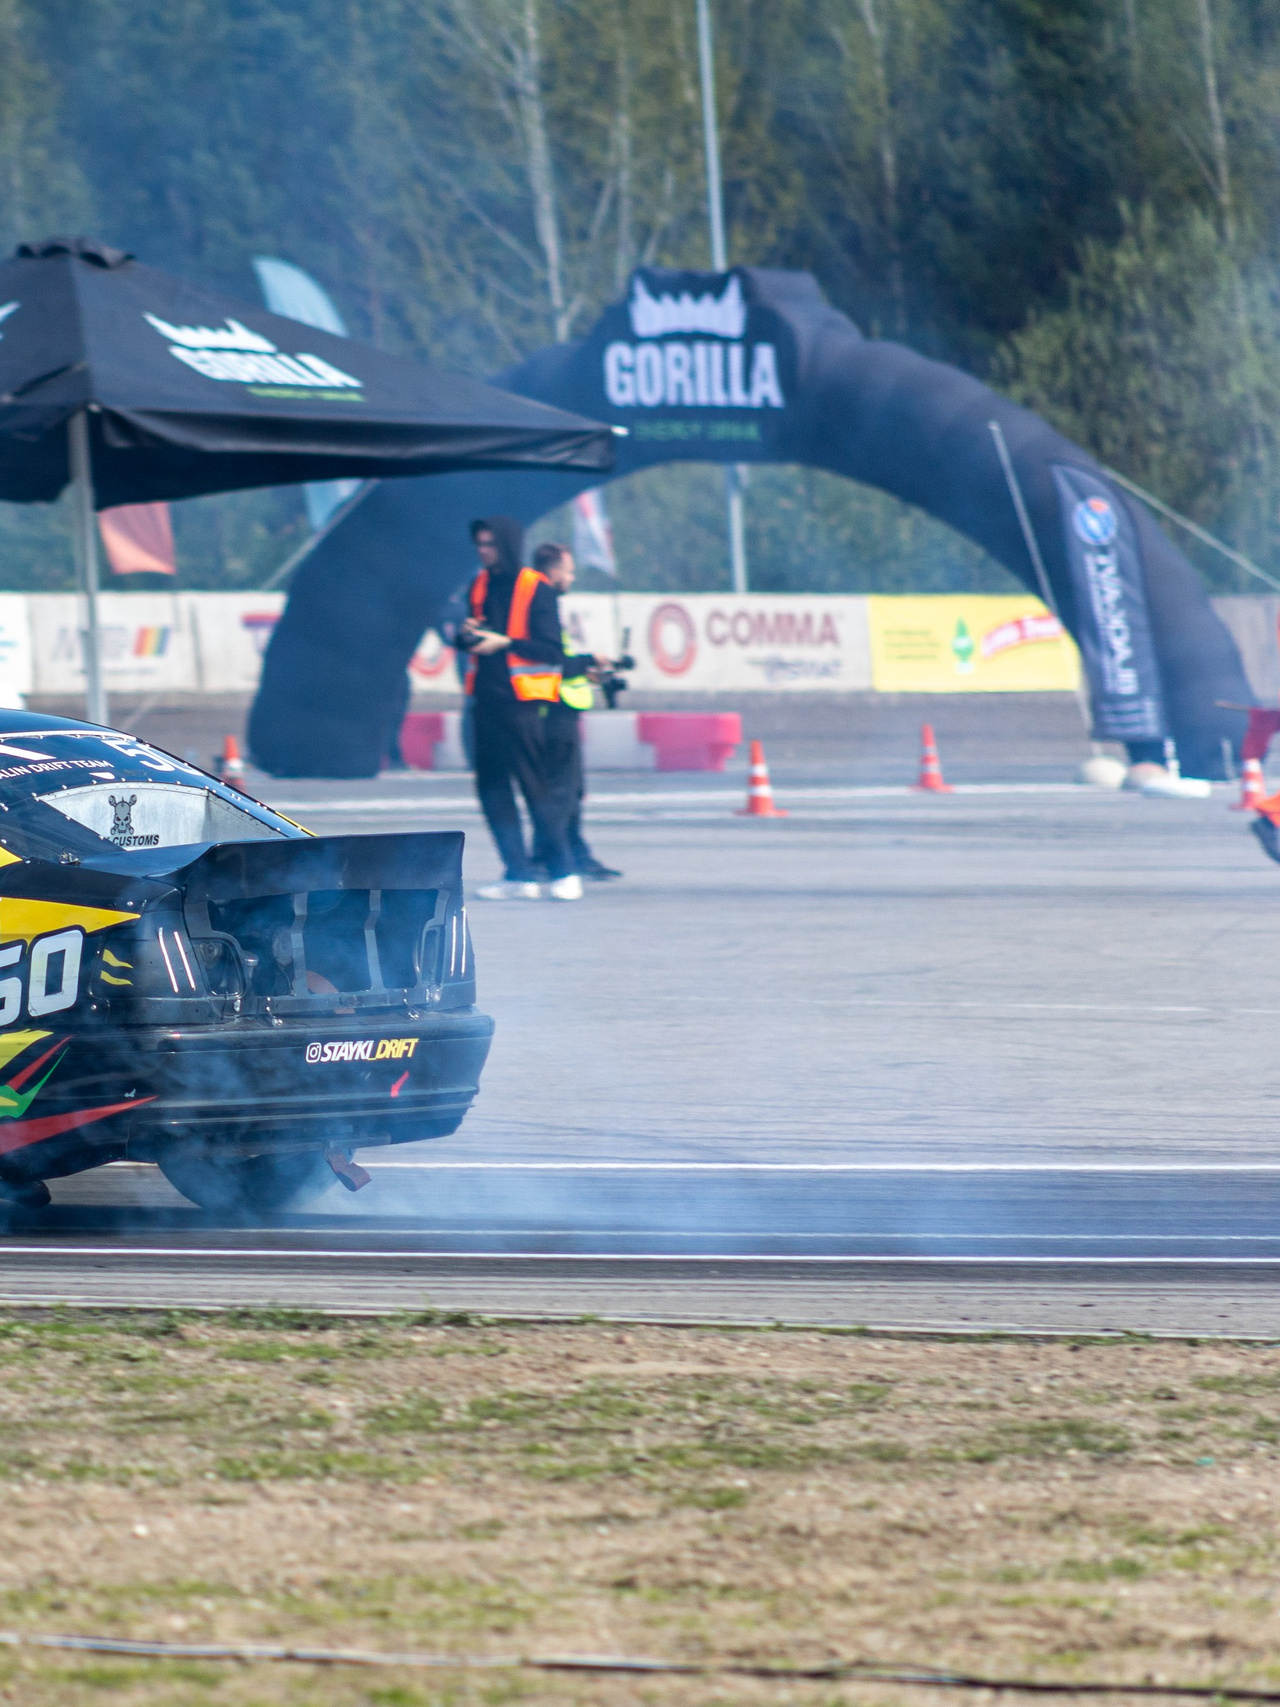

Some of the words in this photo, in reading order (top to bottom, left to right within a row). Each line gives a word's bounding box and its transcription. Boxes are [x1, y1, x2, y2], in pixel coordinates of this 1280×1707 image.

[168, 344, 363, 388] GORILLA
[603, 340, 786, 409] GORILLA
[705, 609, 841, 648] COMMA
[31, 760, 70, 775] DRIFT
[68, 758, 115, 769] TEAM
[112, 834, 160, 847] CUSTOMS
[320, 1038, 419, 1063] STAYKI_DRIFT
